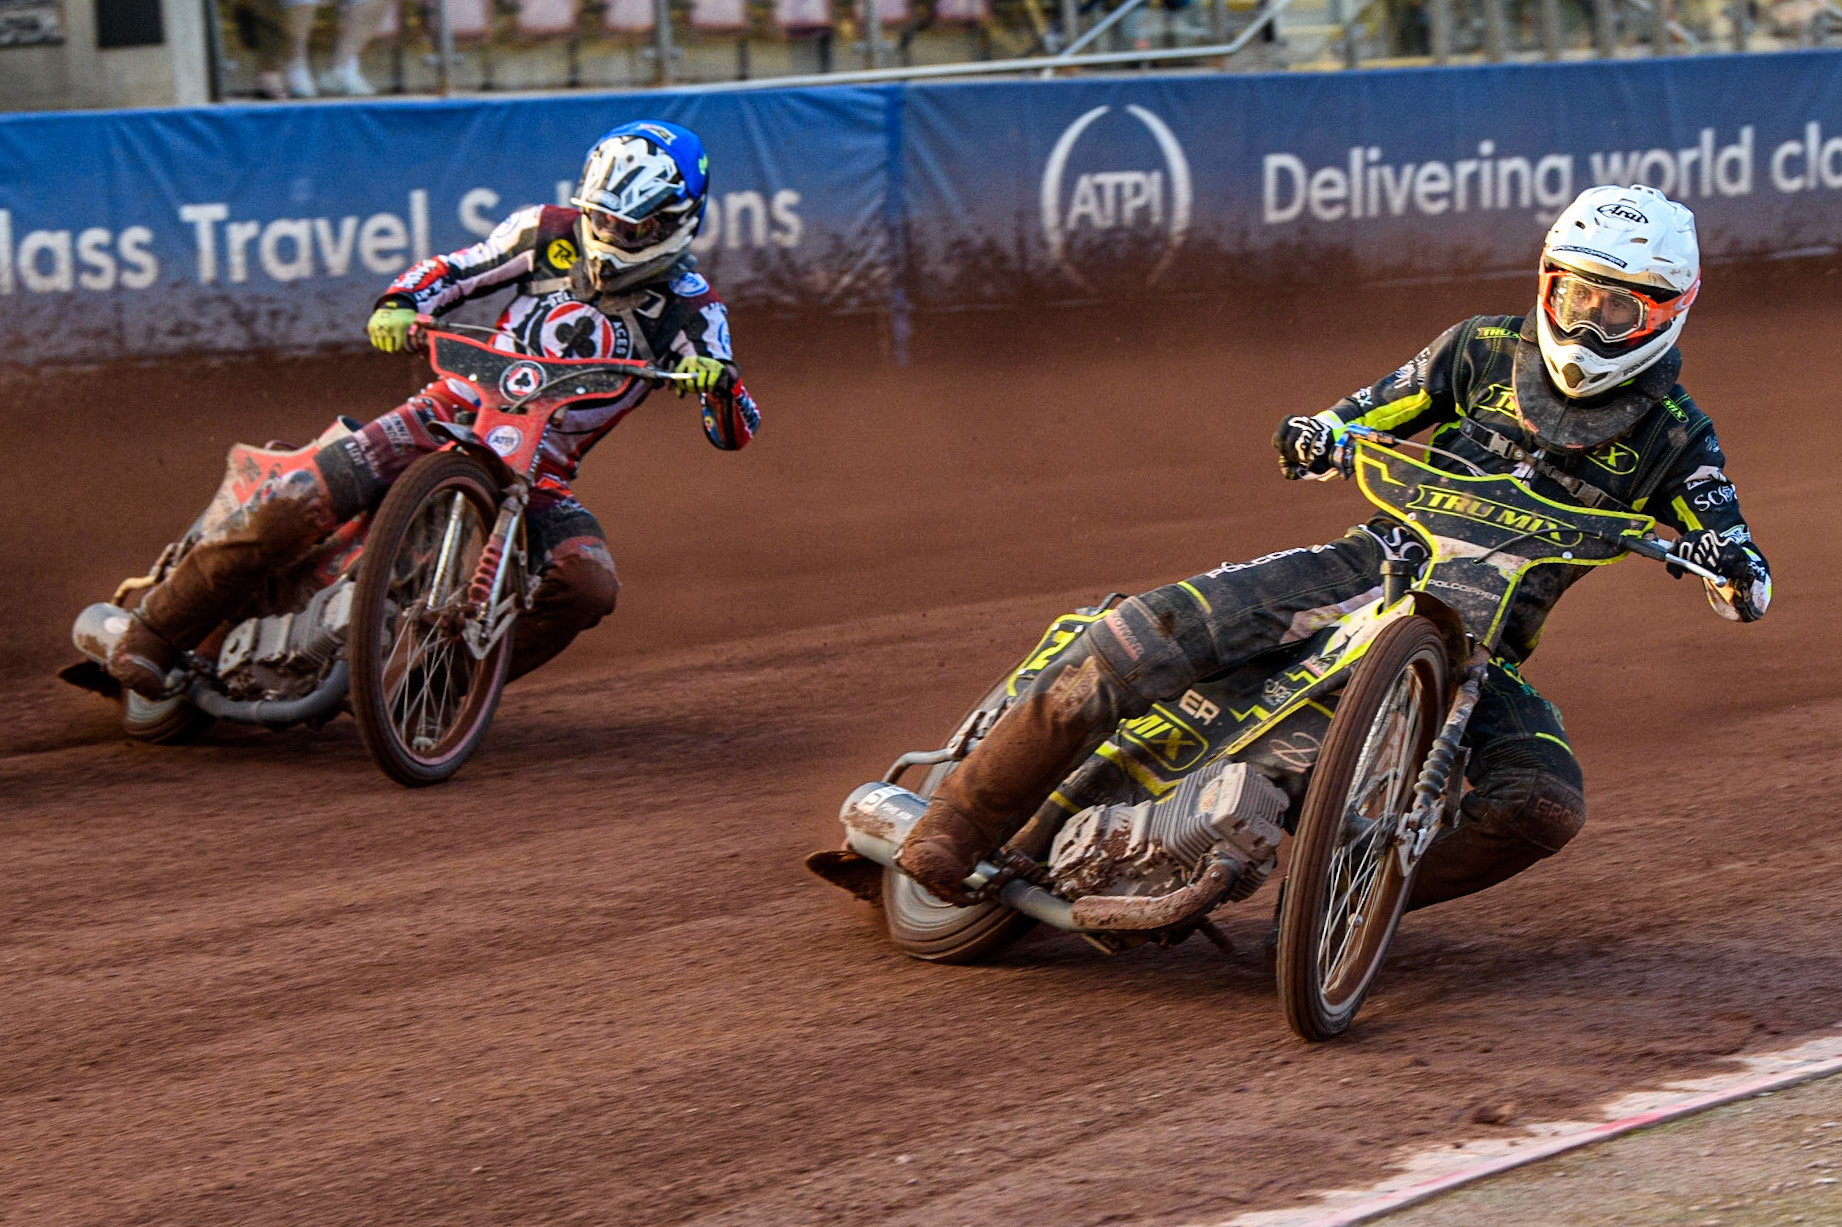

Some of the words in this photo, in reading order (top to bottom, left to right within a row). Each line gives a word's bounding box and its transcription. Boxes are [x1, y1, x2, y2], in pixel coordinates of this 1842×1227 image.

[1066, 170, 1164, 230] ATPI
[1262, 139, 1573, 227] Delivering
[1589, 125, 1754, 199] world
[179, 189, 430, 284] Travel
[1608, 205, 1645, 223] Arai
[1427, 491, 1495, 518] TRU
[1496, 509, 1562, 542] MIX
